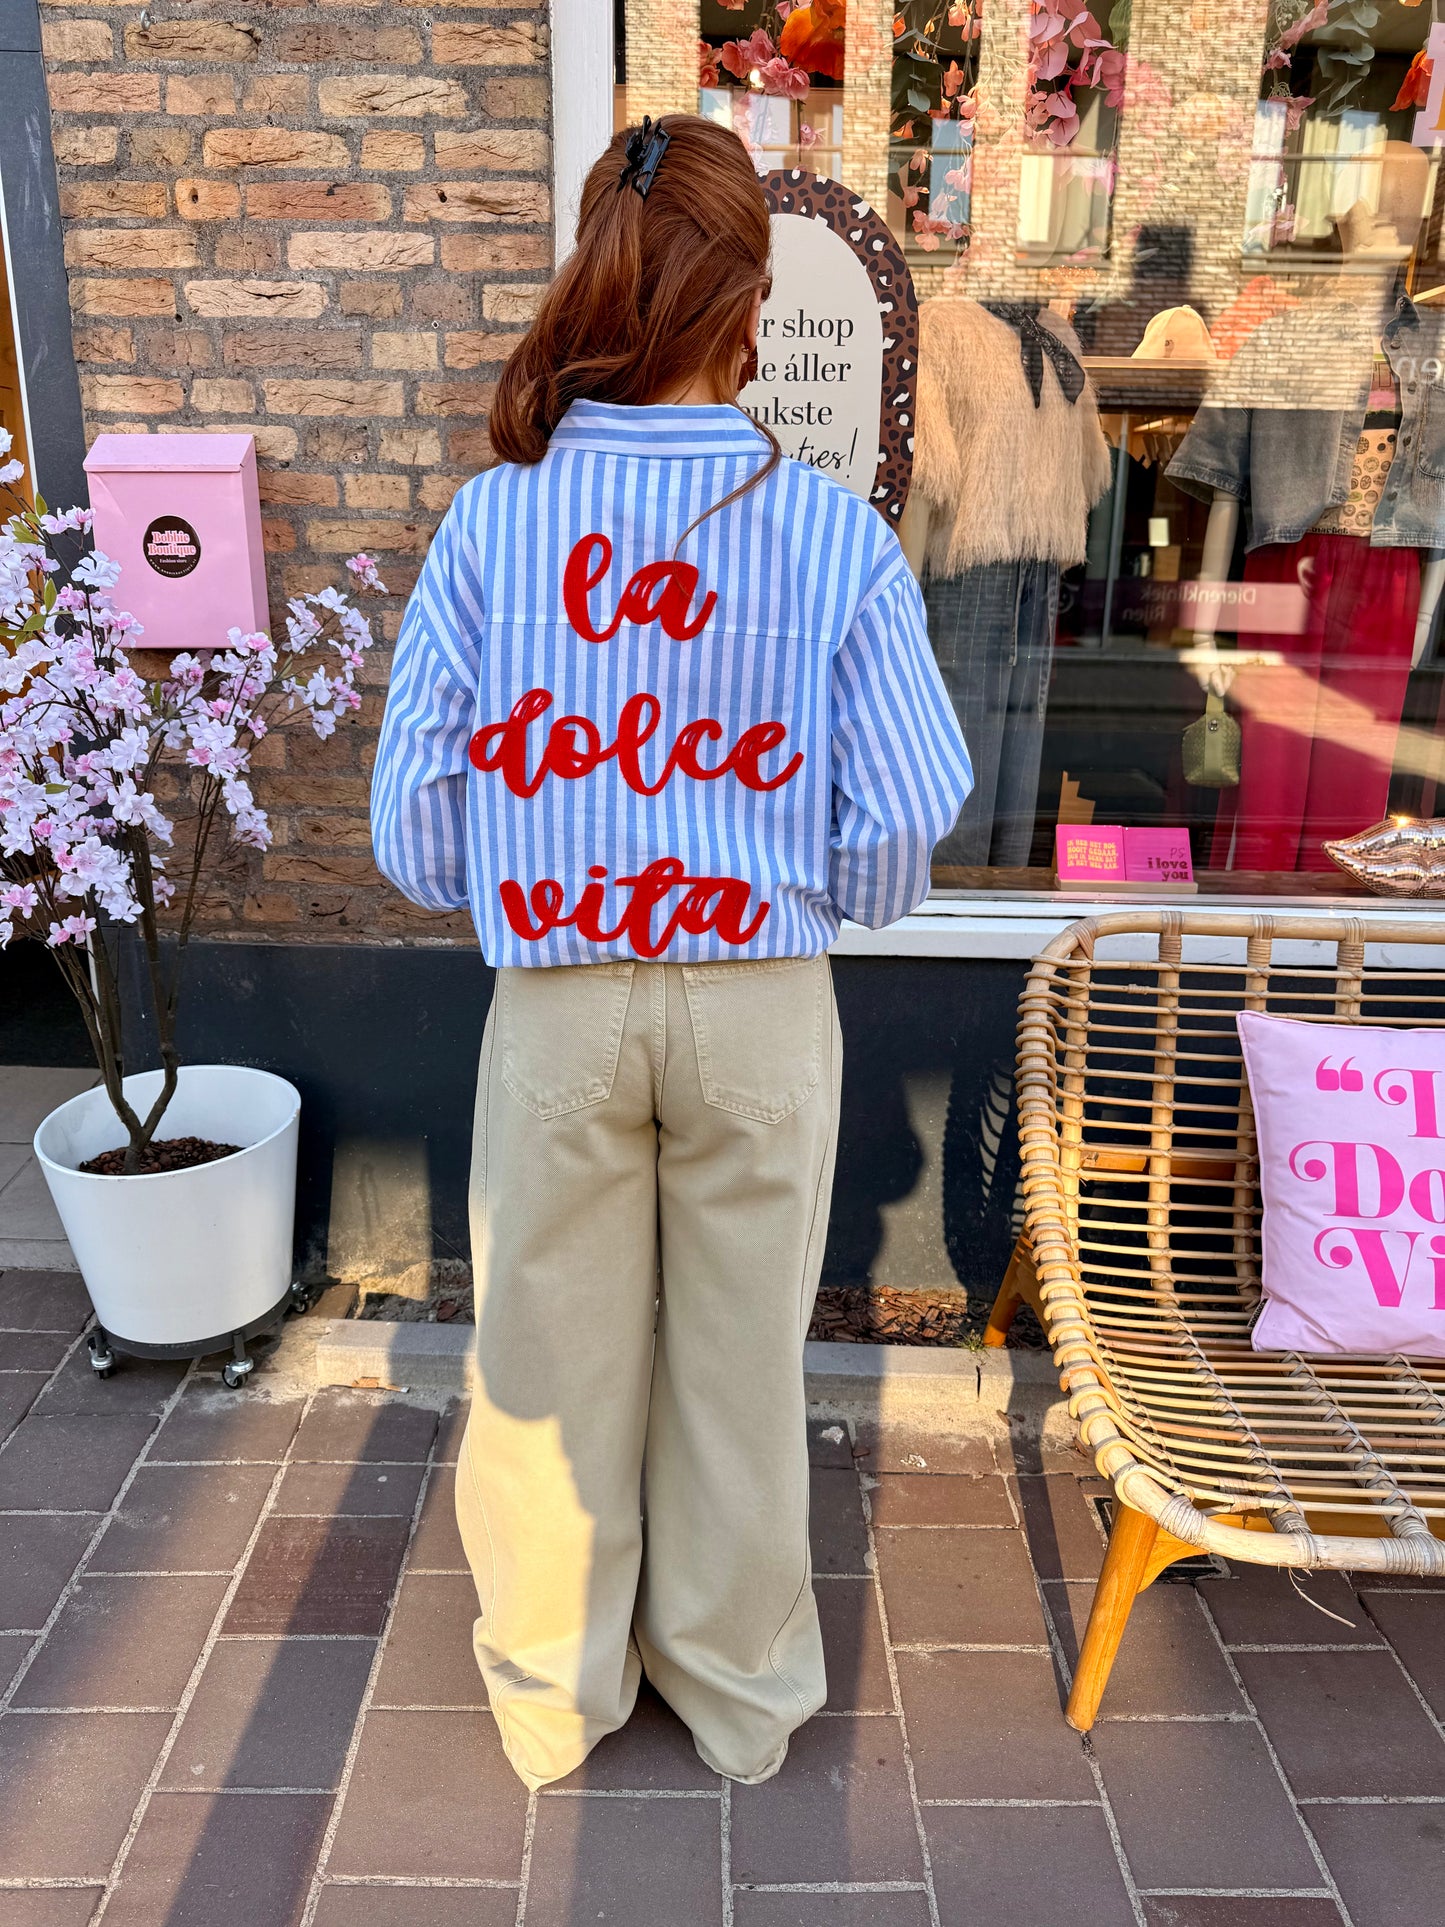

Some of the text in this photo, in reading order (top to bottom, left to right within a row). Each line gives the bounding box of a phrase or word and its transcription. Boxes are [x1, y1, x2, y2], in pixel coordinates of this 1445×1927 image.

[782, 309, 854, 346] shop
[784, 353, 851, 382] áller
[790, 427, 858, 479] ties!
[148, 544, 197, 557] Boutique
[152, 531, 190, 543] Bobbie
[563, 533, 718, 643] la
[469, 688, 804, 799] dolce
[1147, 857, 1188, 869] i love
[1162, 871, 1189, 882] you
[499, 857, 770, 958] vita
